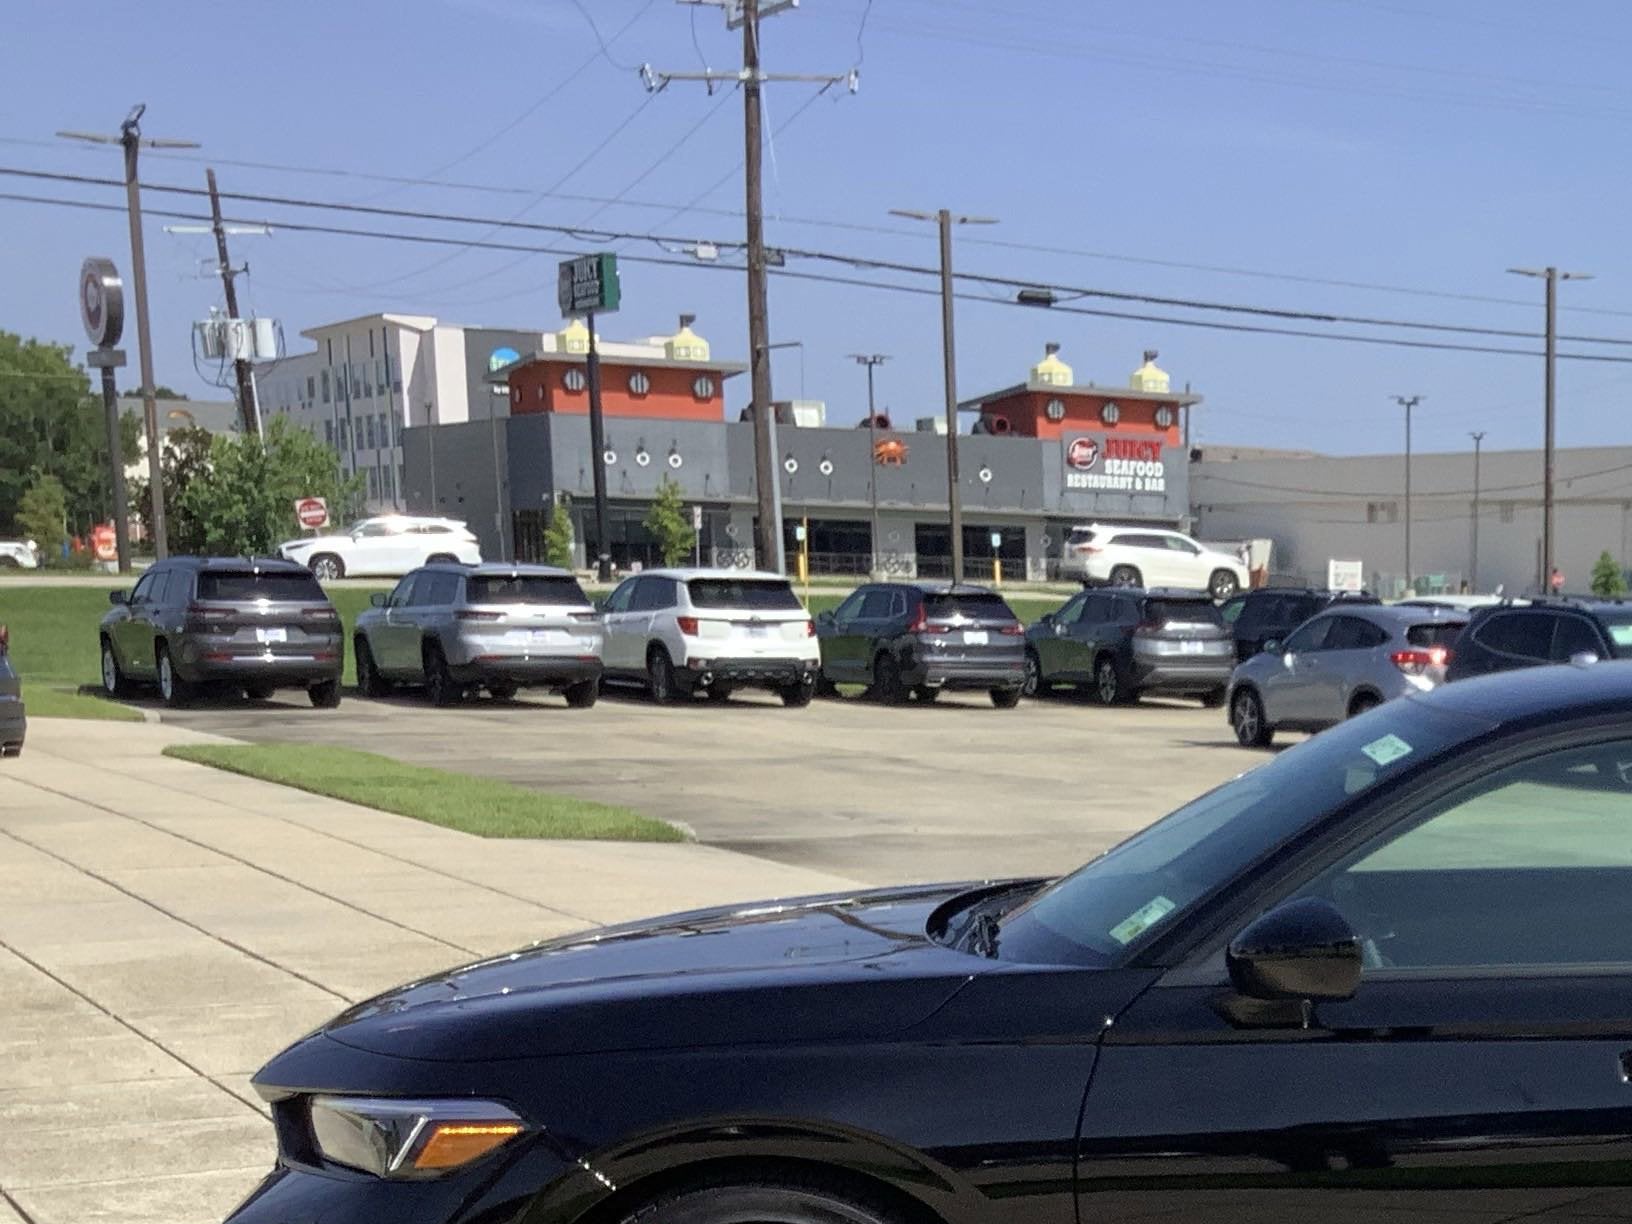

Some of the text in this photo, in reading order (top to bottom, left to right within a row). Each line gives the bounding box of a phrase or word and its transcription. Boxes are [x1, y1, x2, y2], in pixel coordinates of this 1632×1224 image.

[1102, 439, 1161, 462] JUICY
[1104, 459, 1164, 477] SEAFOOD
[1067, 473, 1133, 490] RESTAURANT
[1144, 478, 1165, 492] BAR
